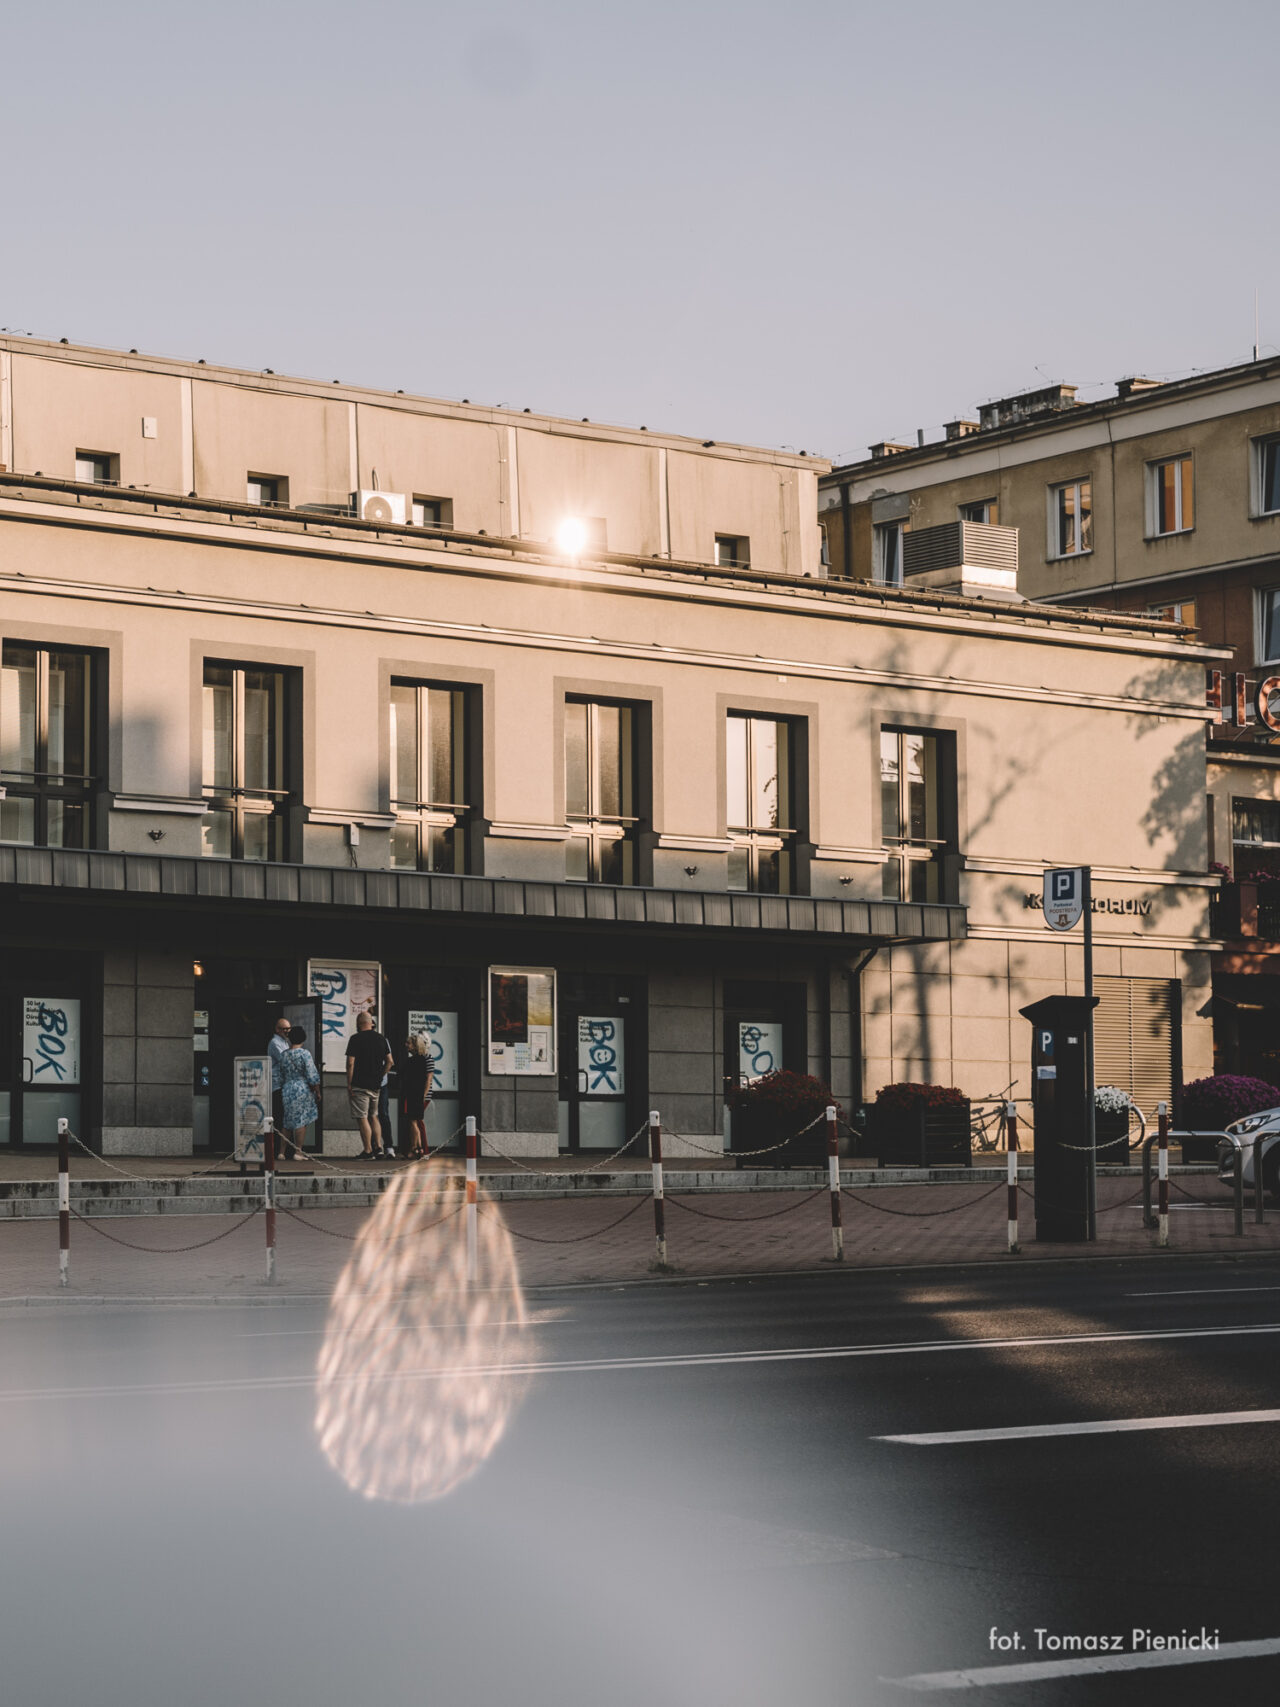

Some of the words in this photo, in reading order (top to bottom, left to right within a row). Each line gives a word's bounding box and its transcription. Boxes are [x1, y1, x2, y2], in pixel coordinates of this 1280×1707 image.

[1057, 874, 1071, 898] P
[1090, 898, 1153, 916] ORUM
[35, 1001, 68, 1081] BOK
[589, 1021, 617, 1091] BOK
[743, 1026, 775, 1075] BO
[1042, 1031, 1052, 1052] P
